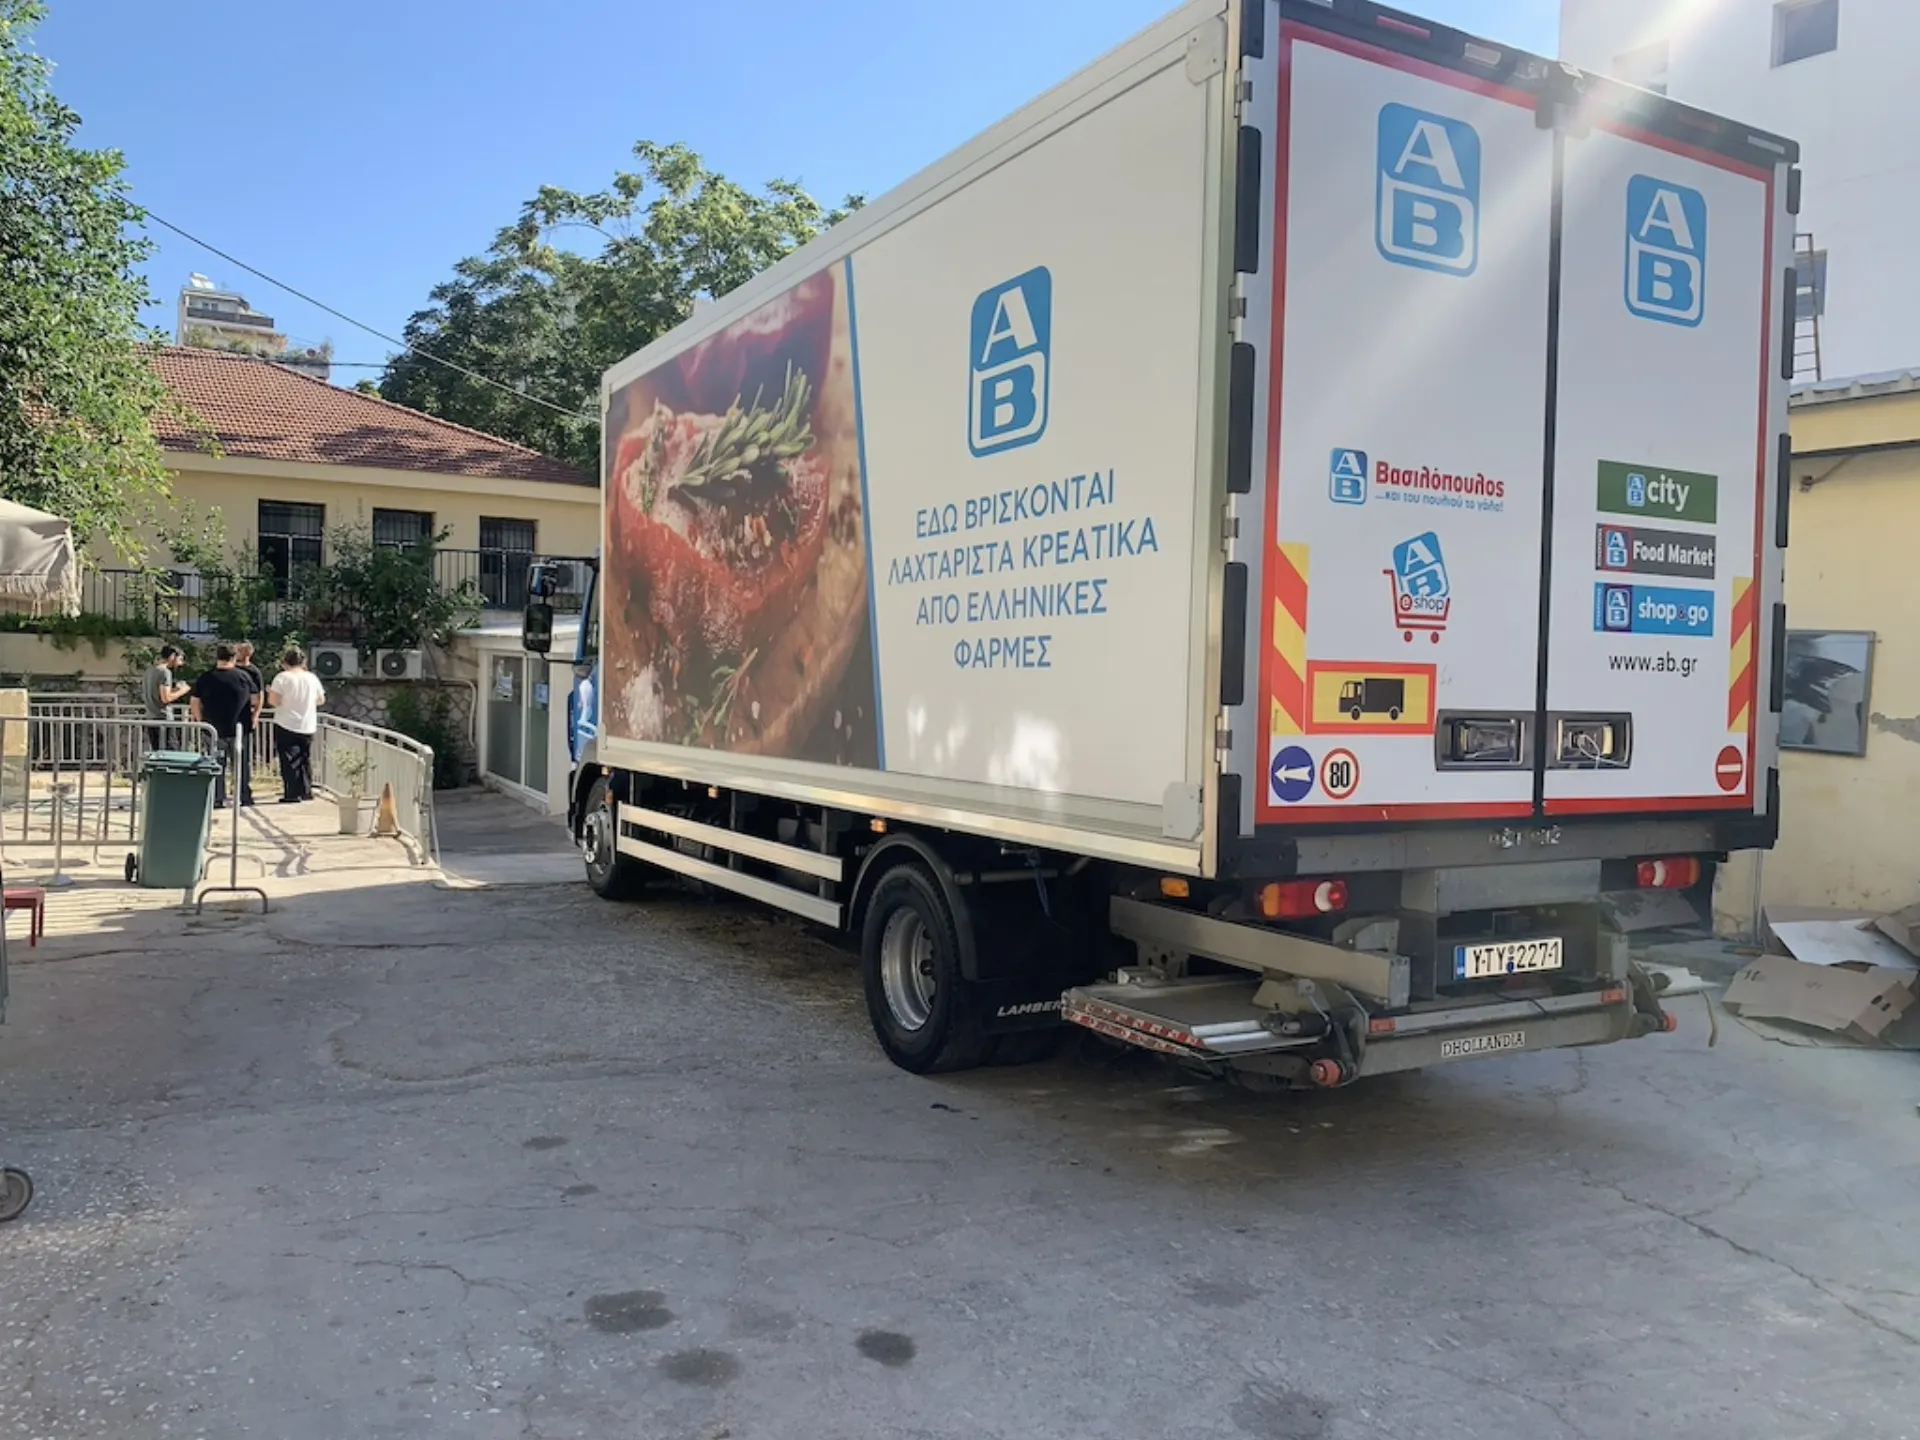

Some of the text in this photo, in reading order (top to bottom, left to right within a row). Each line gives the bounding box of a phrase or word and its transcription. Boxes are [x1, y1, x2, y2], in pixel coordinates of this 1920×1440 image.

[1376, 460, 1505, 498] Βασιλόπουλος
[1647, 474, 1690, 512] city
[916, 468, 1115, 539] ΕΔΩ ΒΡΙΣΚΟΝΤΑΙ
[888, 516, 1159, 586] ΛΑΧΤΑΡΙΣΤΑ ΚΡΕΑΤΙΚΑ
[1632, 540, 1665, 562] Food
[1668, 546, 1714, 567] Market
[916, 578, 1108, 626] ΑΠΟ ΕΛΛΗΝΙΚΕΣ
[953, 635, 1052, 669] ΦΑΡΜΕΣ
[1608, 651, 1698, 677] www.ab.gr
[1330, 761, 1350, 788] 80
[1443, 1032, 1525, 1056] DHOLLANDIA
